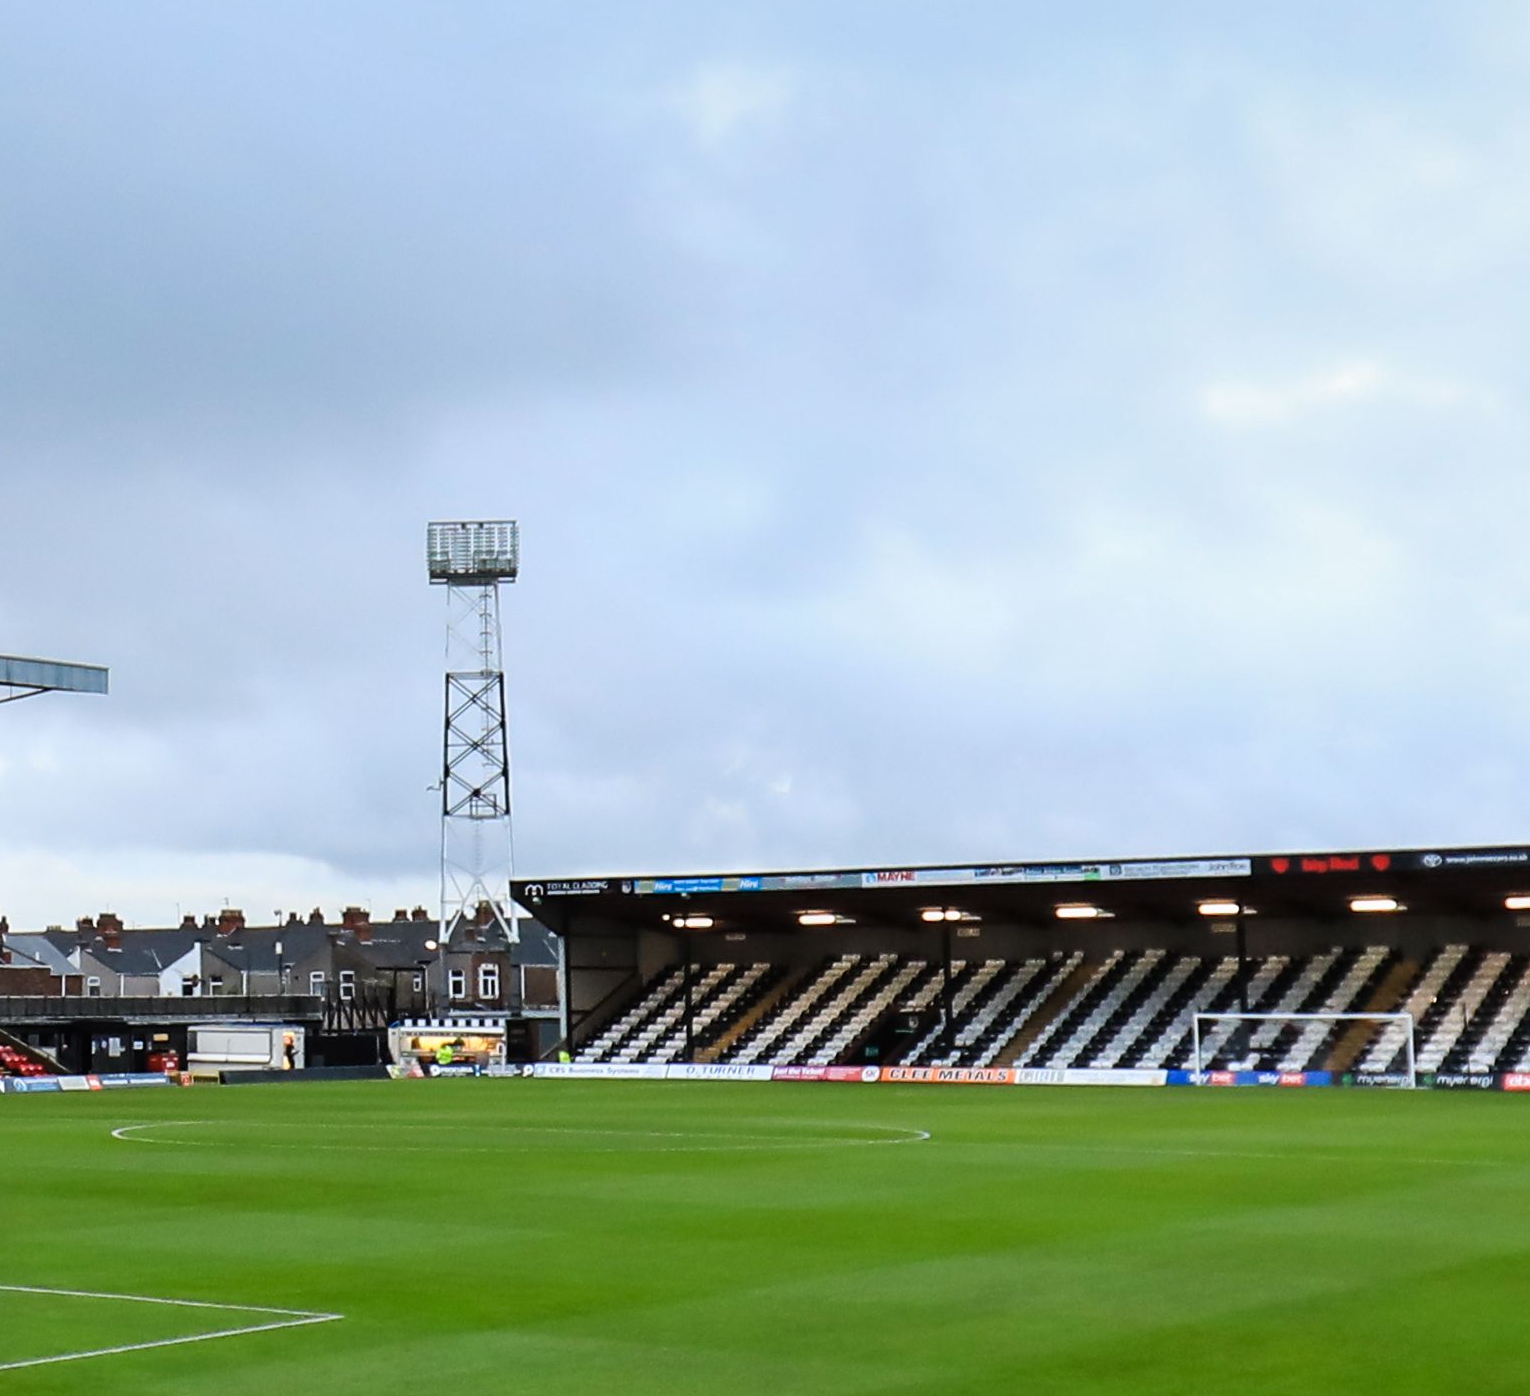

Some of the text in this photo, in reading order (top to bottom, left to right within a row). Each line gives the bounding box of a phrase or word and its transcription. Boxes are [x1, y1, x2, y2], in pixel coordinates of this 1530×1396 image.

[875, 870, 916, 882] MAYNE
[702, 1066, 756, 1076] TURNER
[889, 1069, 929, 1079] CLEE
[938, 1069, 1007, 1081] METALS
[1258, 1072, 1302, 1085] sky bet
